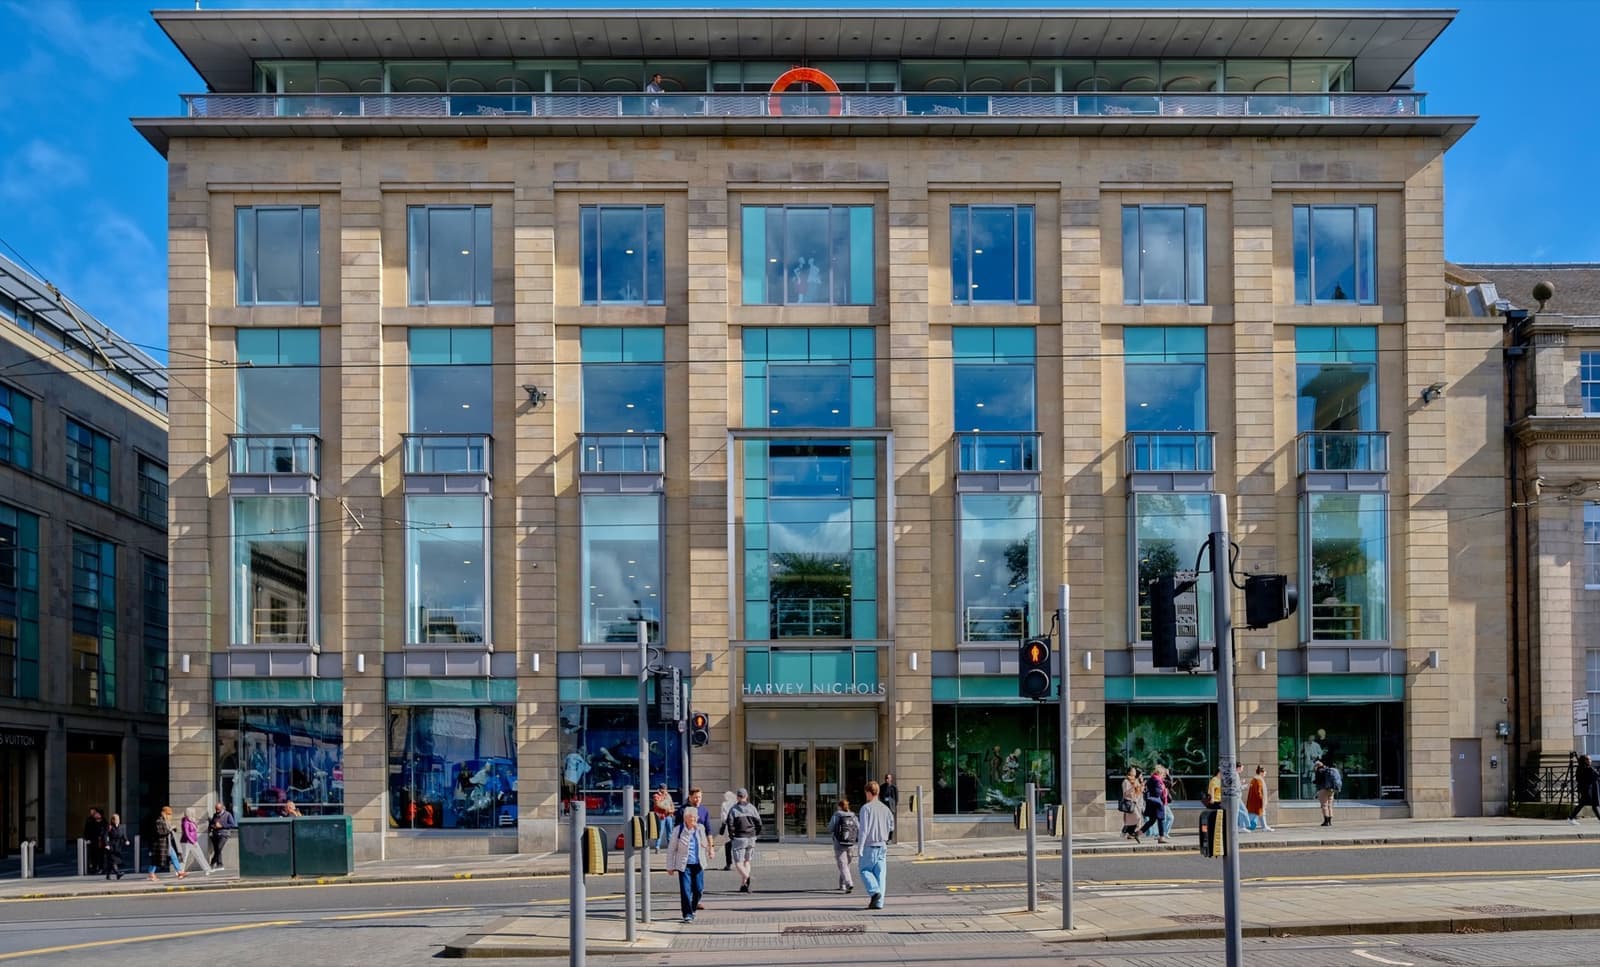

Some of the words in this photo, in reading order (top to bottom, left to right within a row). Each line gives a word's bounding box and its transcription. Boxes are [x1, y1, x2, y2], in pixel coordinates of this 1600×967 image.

[742, 682, 803, 695] HARVEY
[813, 682, 886, 695] NICHOLS
[5, 734, 35, 746] VUITTON
